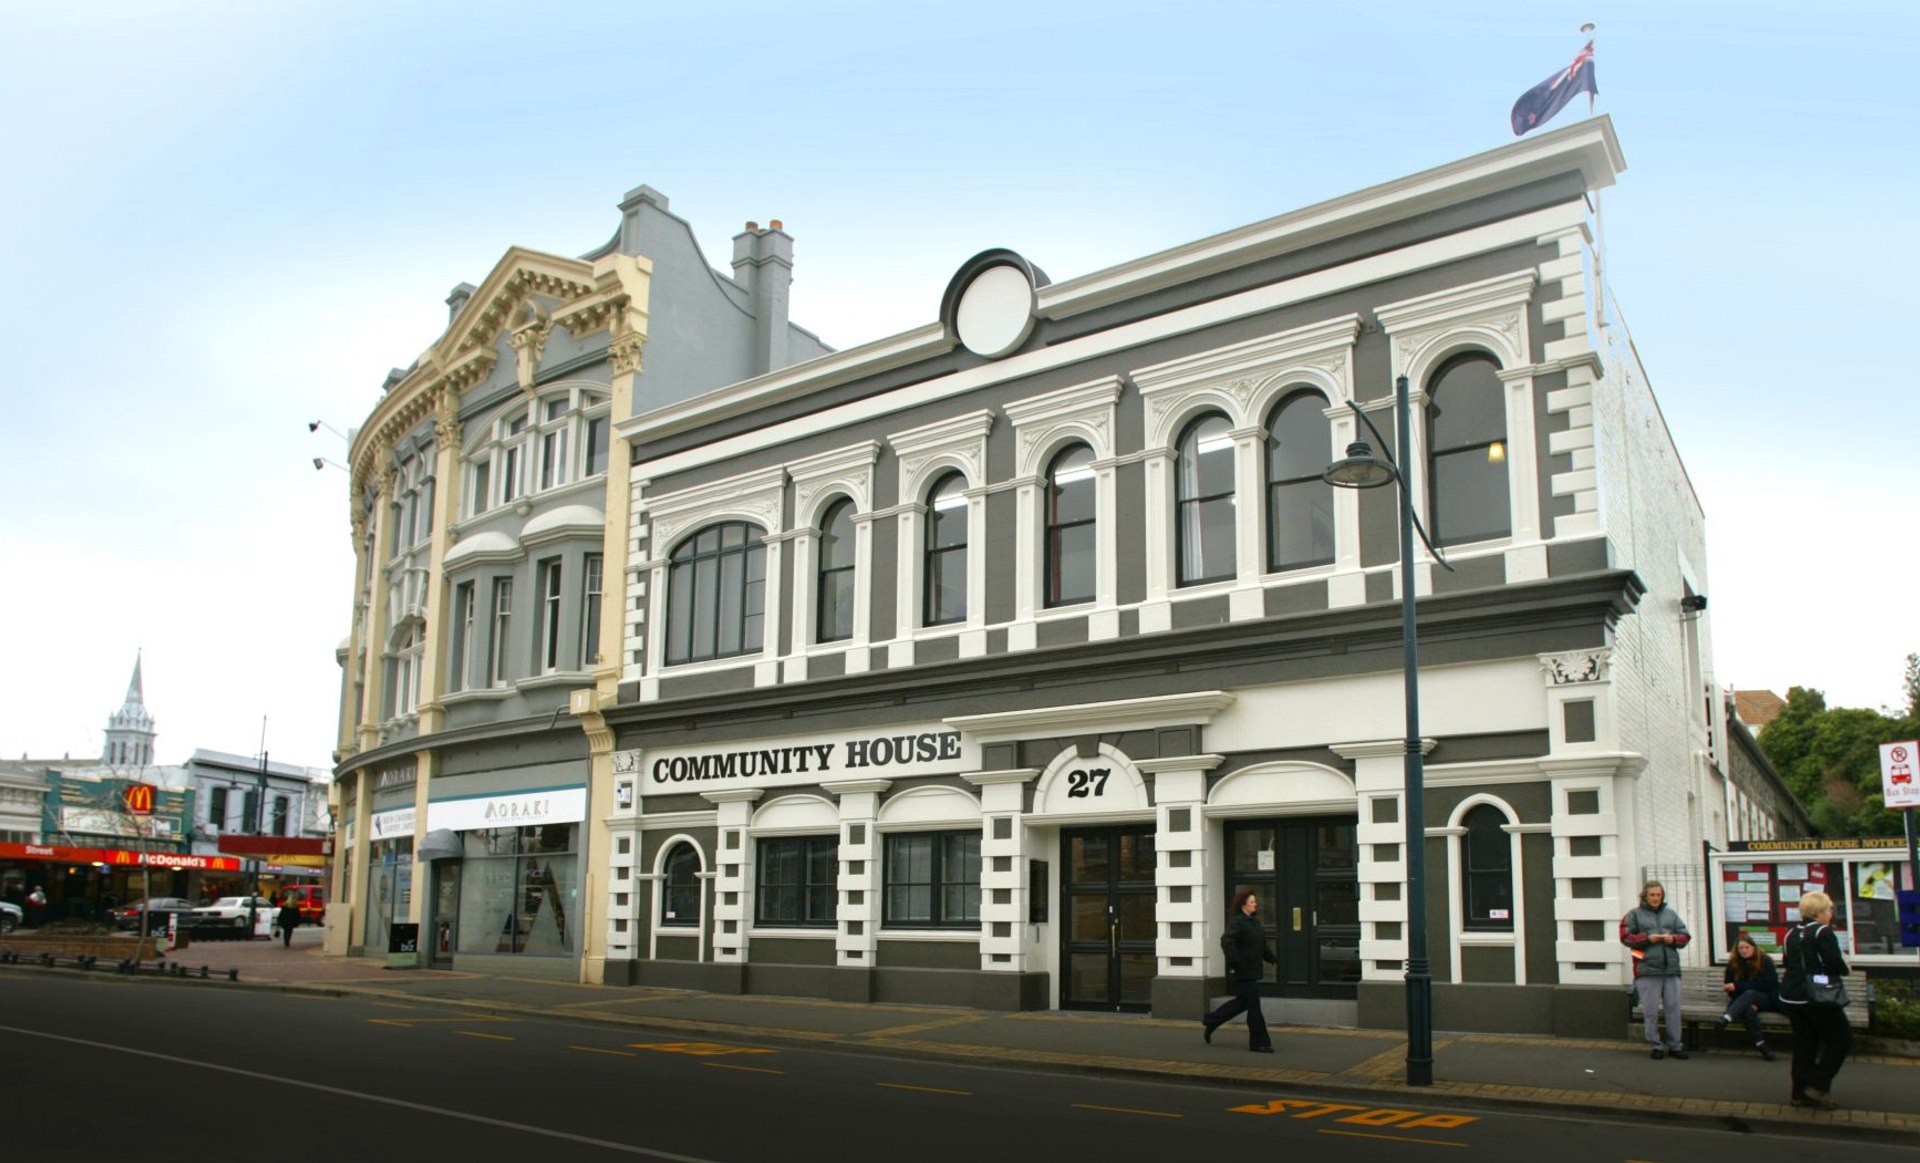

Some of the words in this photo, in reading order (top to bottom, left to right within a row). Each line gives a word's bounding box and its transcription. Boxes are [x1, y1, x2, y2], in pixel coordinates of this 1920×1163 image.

[653, 744, 835, 784] COMMUNITY
[845, 730, 962, 768] HOUSE
[381, 766, 416, 787] AORAKI
[1067, 769, 1111, 798] 27
[485, 799, 550, 819] AORAKI
[25, 845, 54, 856] Street
[1748, 840, 1818, 851] COMMUNITY
[1821, 839, 1859, 849] HOUSE
[1225, 1099, 1480, 1128] STOP
